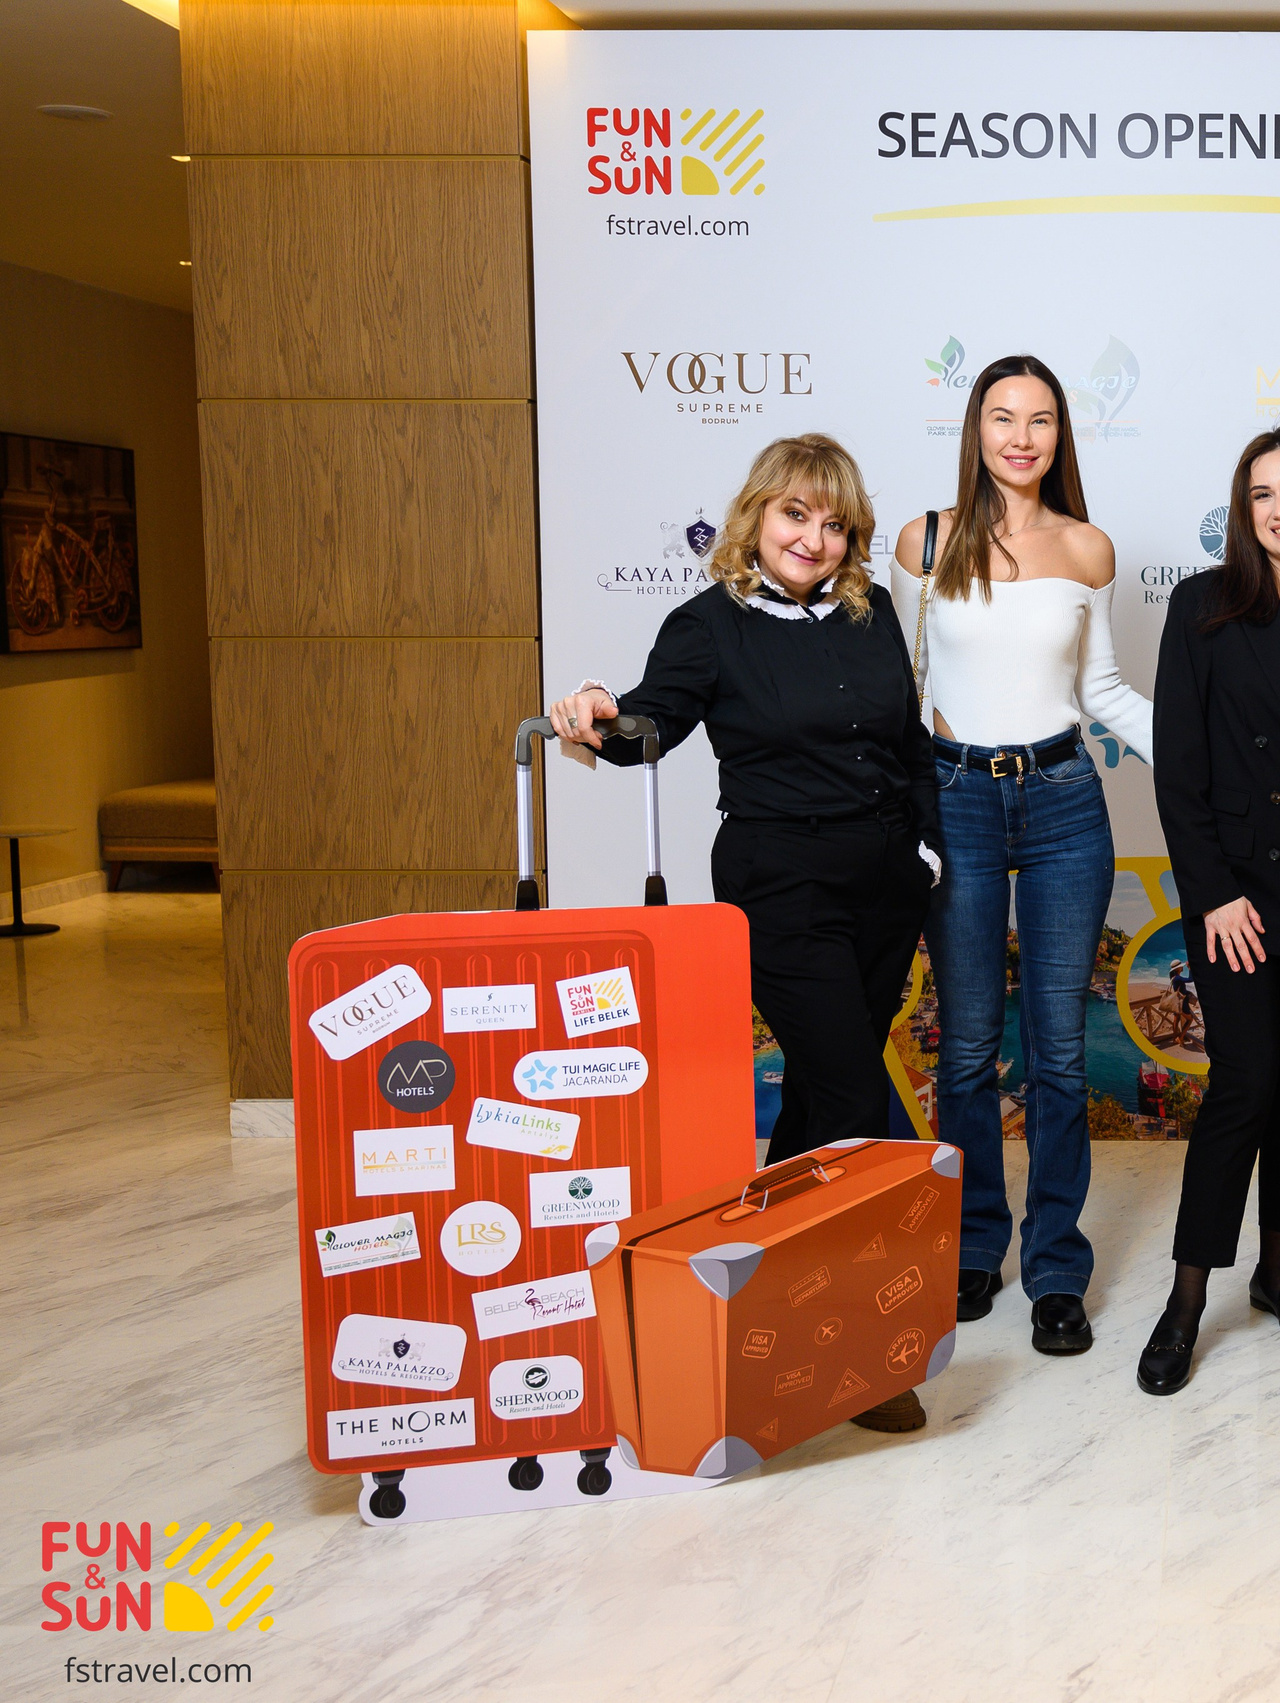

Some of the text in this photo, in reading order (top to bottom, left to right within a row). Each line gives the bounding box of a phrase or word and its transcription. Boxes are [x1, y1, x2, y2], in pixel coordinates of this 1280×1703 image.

[586, 108, 671, 148] FUN
[877, 112, 1097, 159] SEASON
[620, 141, 636, 161] &
[606, 215, 749, 236] fstravel.com
[621, 352, 812, 394] VOGUE
[677, 403, 763, 413] SUPREME
[615, 567, 674, 582] KAYA
[637, 587, 686, 595] HOTELS
[568, 984, 591, 999] FUN
[318, 975, 416, 1037] VOGUE
[451, 1004, 528, 1016] SERENITY
[357, 1009, 399, 1035] SUPREME
[574, 1008, 630, 1027] LIFE BELEK
[562, 1062, 640, 1074] TUI MAGIC LIFE
[563, 1074, 628, 1087] JACARANDA
[397, 1087, 434, 1097] HOTELS
[362, 1147, 446, 1164] MARTI
[542, 1199, 620, 1213] GREENWOOD
[594, 1209, 619, 1217] Hotels
[908, 1200, 923, 1217] VISA
[909, 1191, 935, 1229] APPROVED
[456, 1222, 507, 1247] LRS
[459, 1248, 504, 1256] HOTELS
[794, 1280, 828, 1305] DEPARTURE
[884, 1281, 919, 1308] APPROVED
[885, 1275, 912, 1297] VISA
[484, 1288, 585, 1316] BELEK BEACH
[752, 1335, 767, 1345] VISA
[889, 1332, 919, 1357] ARRIVAL
[348, 1358, 445, 1376] KAYA PALAZZO
[359, 1369, 387, 1377] HOTELS
[400, 1373, 432, 1381] RESORTS
[777, 1375, 810, 1389] APPROVED
[786, 1372, 801, 1380] VISA
[495, 1389, 578, 1407] SHERWOOD
[509, 1406, 530, 1414] Resorts
[546, 1402, 565, 1410] Hotels
[337, 1410, 467, 1435] THE NORM
[382, 1437, 424, 1446] HOTELS
